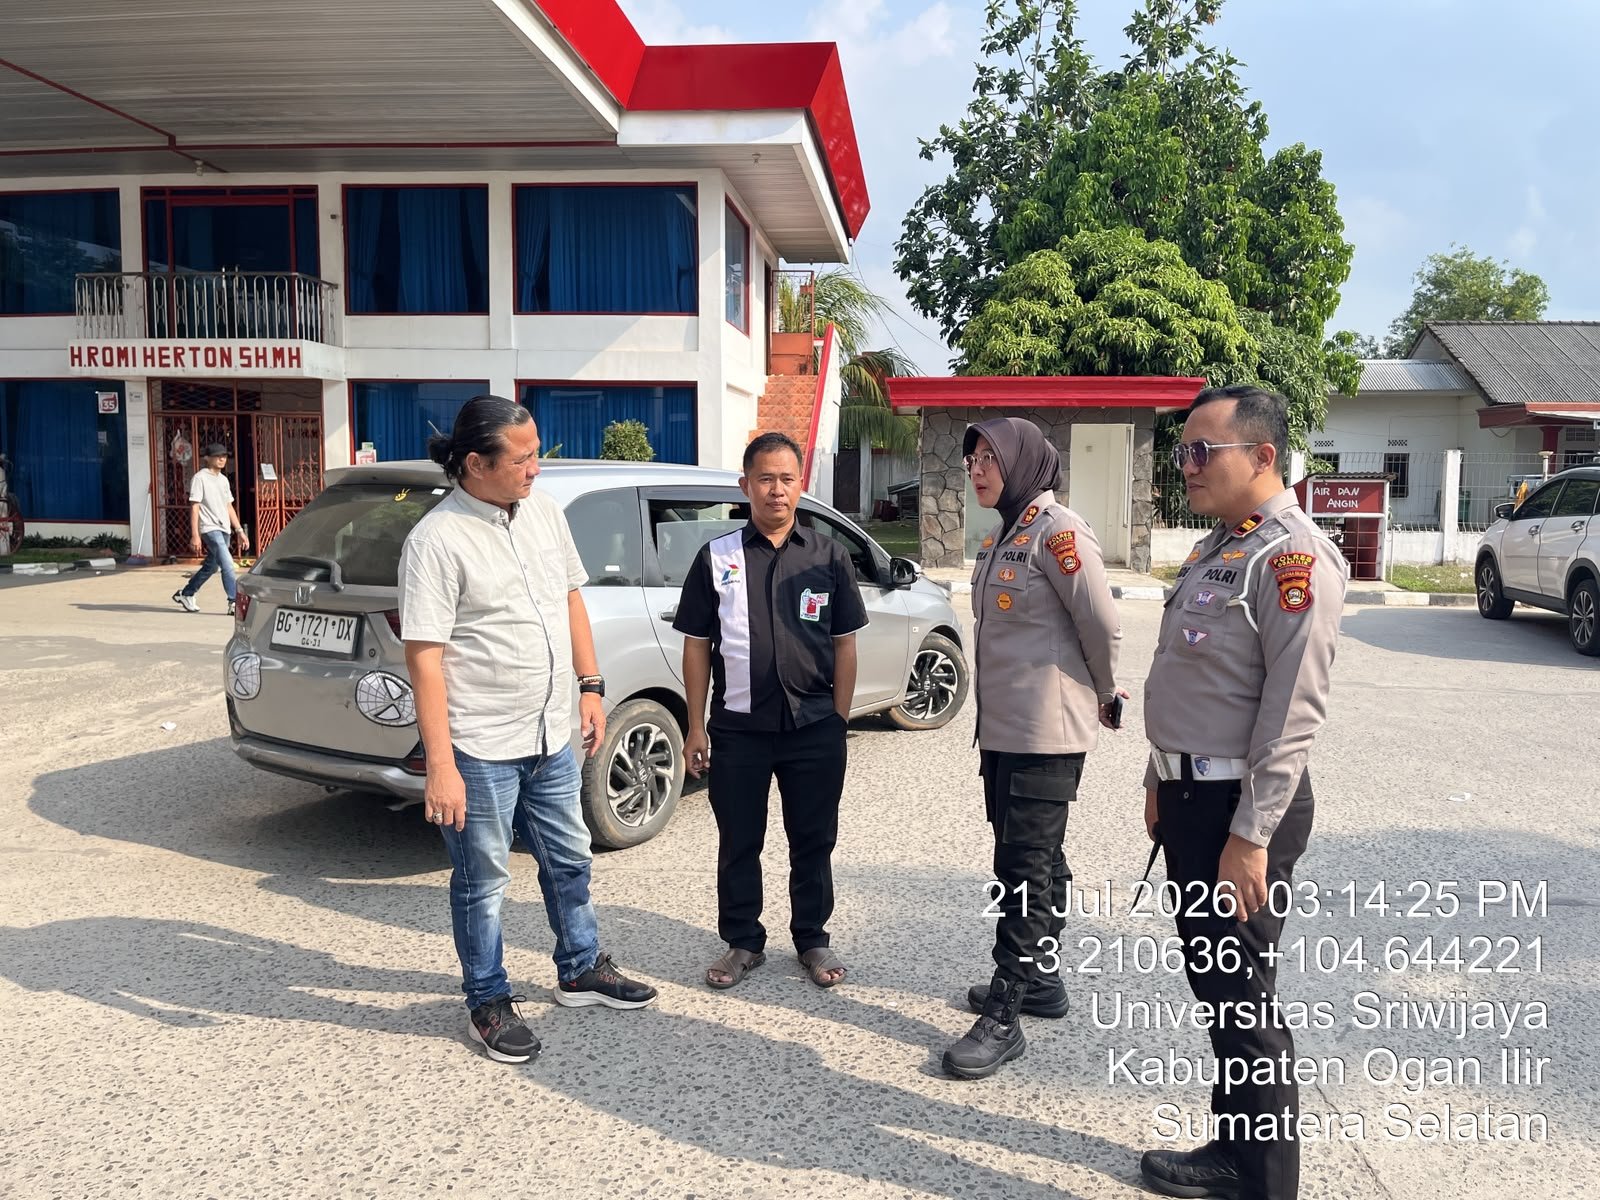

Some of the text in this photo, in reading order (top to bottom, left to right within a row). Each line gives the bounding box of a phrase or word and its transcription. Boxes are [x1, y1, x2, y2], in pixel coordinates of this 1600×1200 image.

[70, 345, 137, 368] H.ROMI
[1313, 486, 1360, 496] AIR DAN
[1326, 497, 1359, 509] ANGIN
[1001, 551, 1028, 563] POLRI
[1273, 553, 1313, 565] POLRES
[1202, 568, 1238, 585] POLRI
[276, 611, 354, 641] BG 1721 DX
